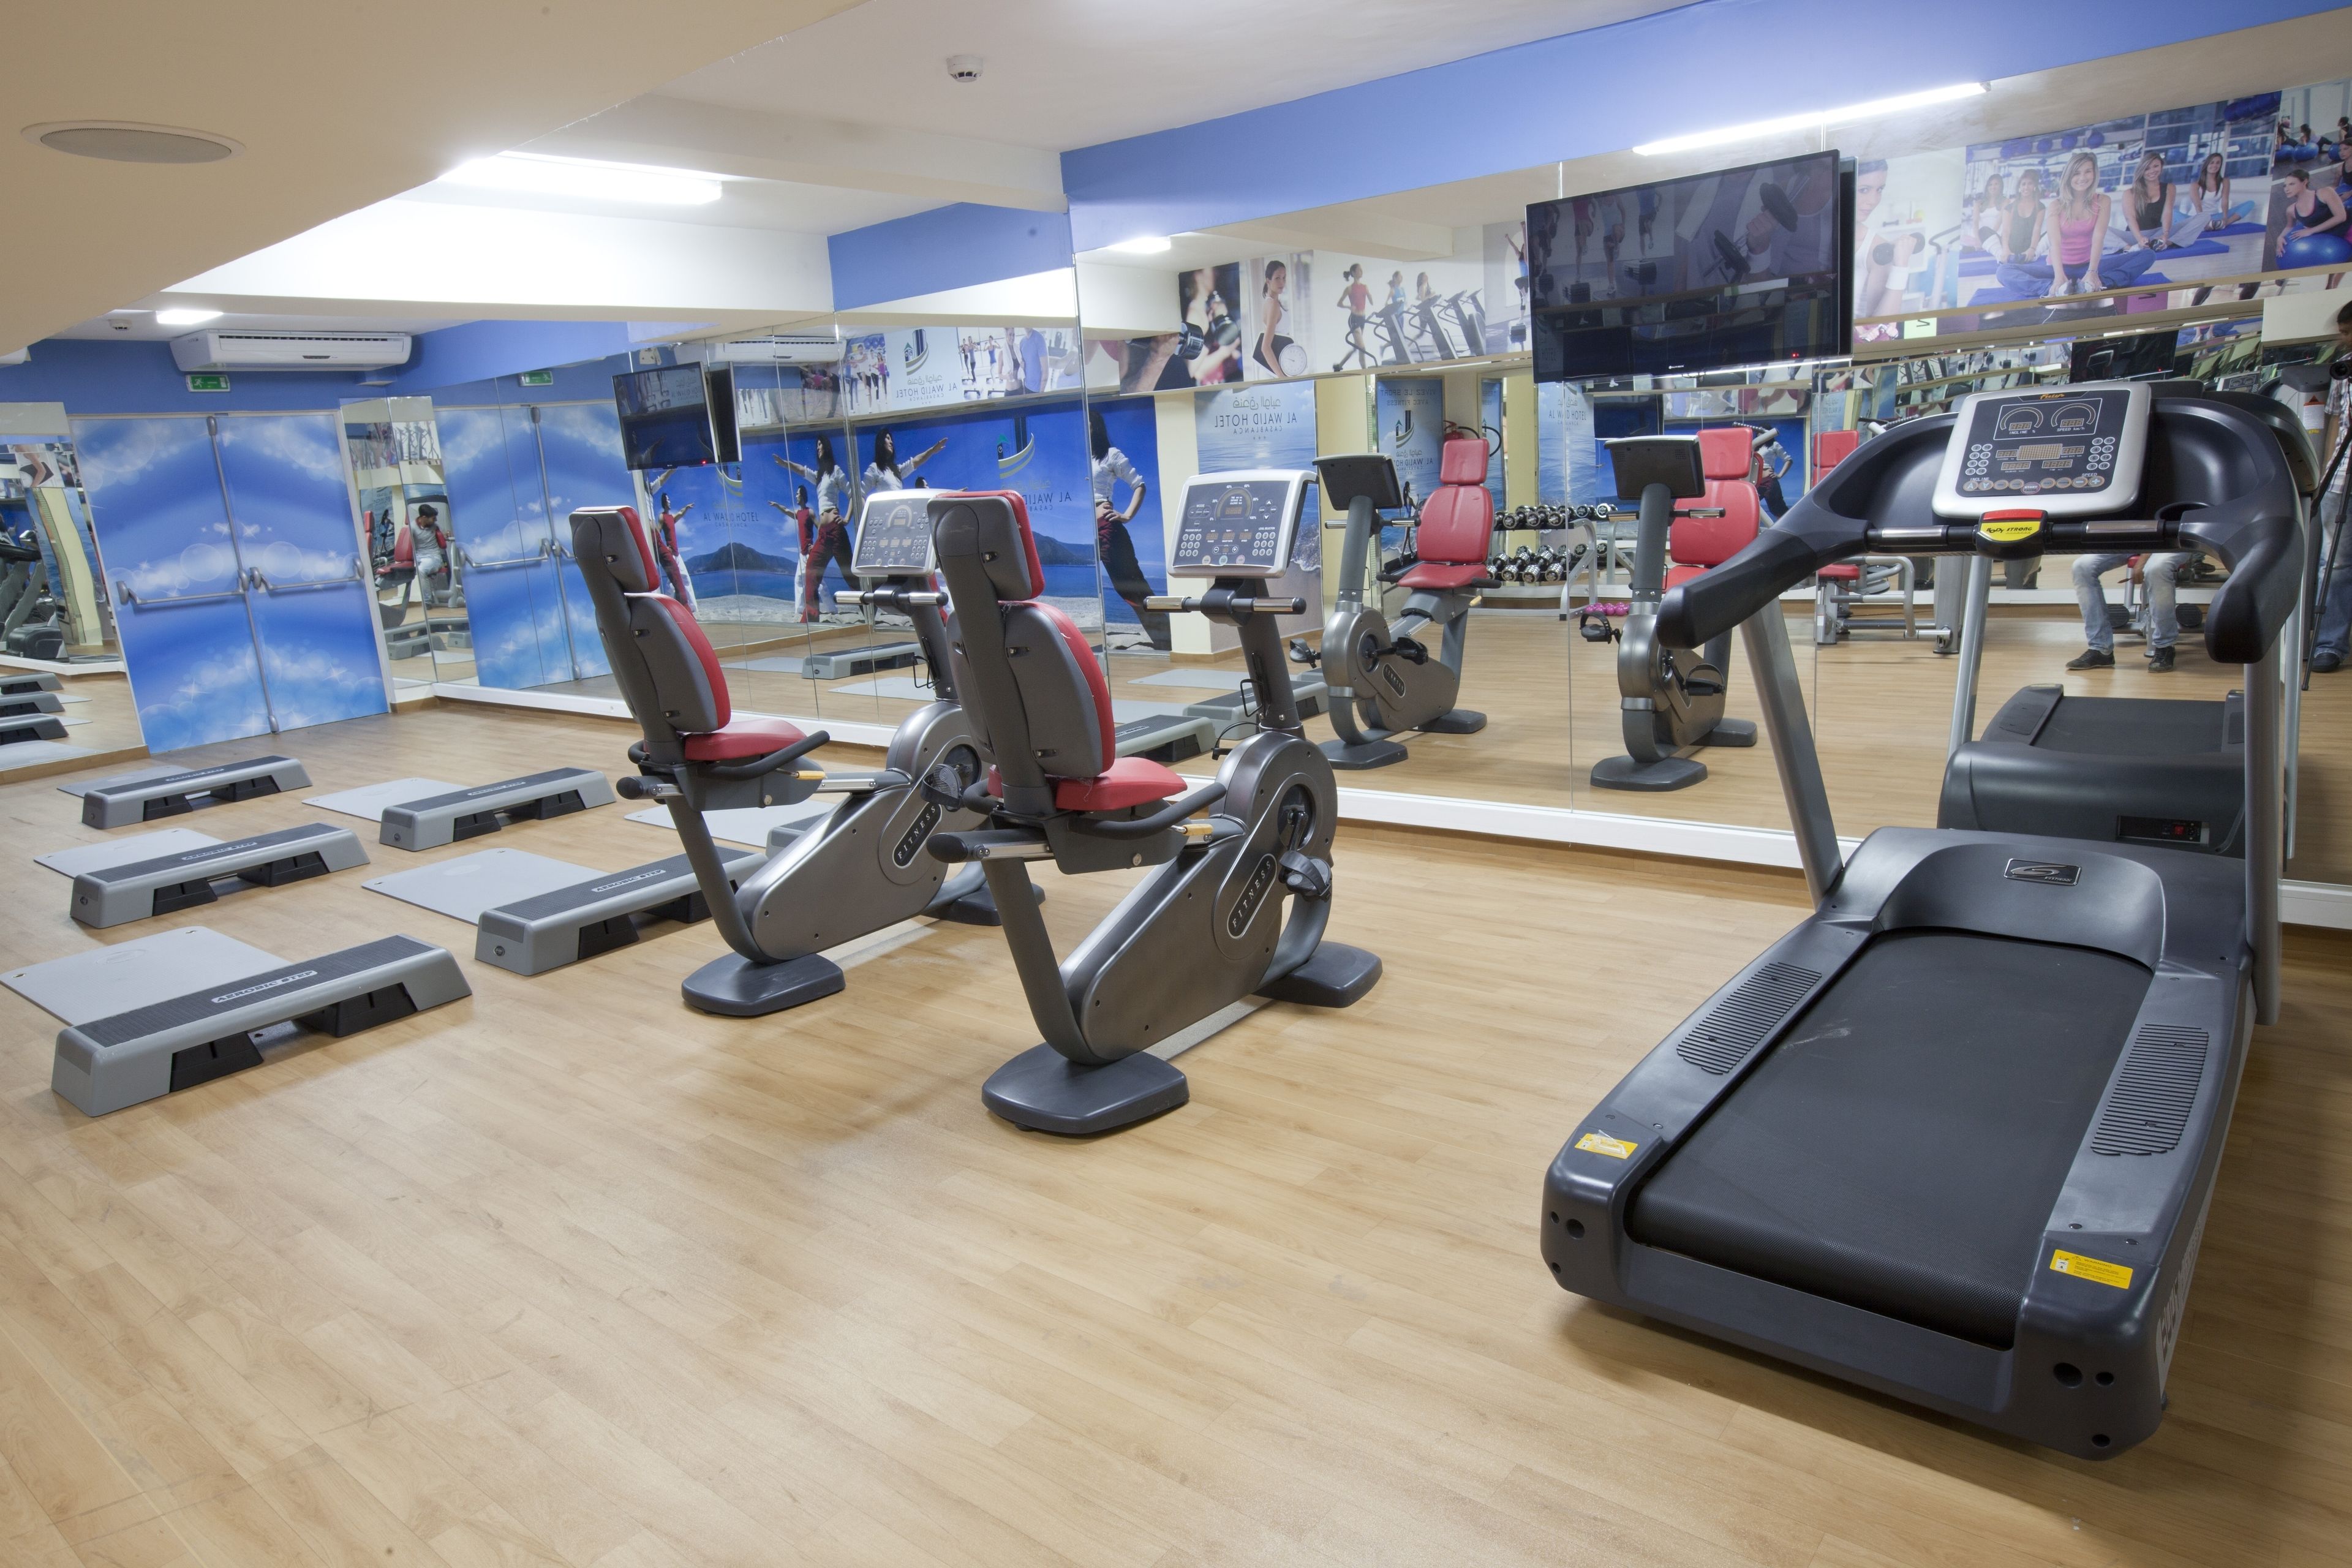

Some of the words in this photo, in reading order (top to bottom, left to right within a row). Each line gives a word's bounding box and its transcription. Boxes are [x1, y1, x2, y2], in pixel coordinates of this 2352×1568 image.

[736, 512, 759, 521] HOTEL
[898, 805, 935, 859] FITNESS
[597, 876, 638, 891] AEROBIC
[639, 869, 662, 878] STEP
[1232, 861, 1270, 927] FITNESS
[217, 981, 278, 1002] AEROBIC
[281, 971, 314, 982] STEP
[2084, 1259, 2112, 1268] WARNING
